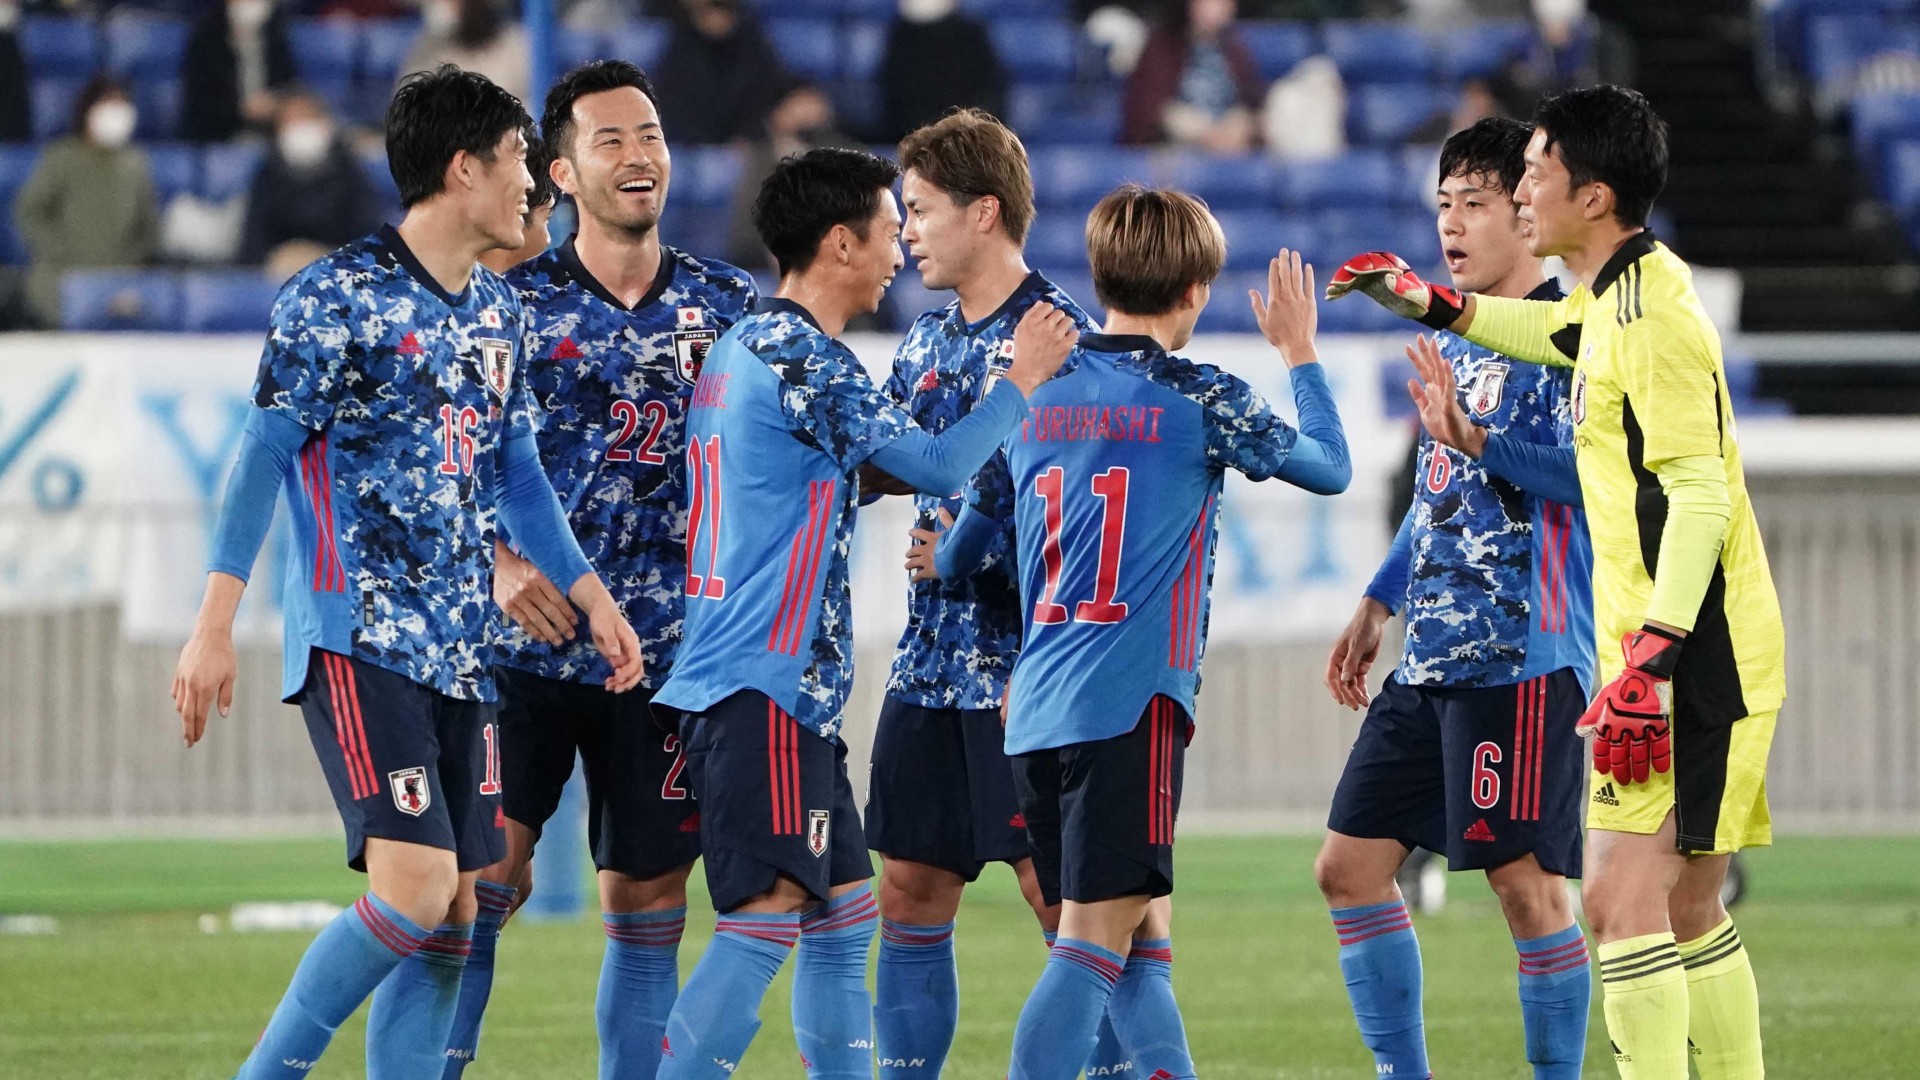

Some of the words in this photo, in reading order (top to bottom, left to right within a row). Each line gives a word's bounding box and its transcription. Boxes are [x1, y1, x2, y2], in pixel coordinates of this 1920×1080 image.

[682, 332, 708, 340] JAPAN
[439, 403, 479, 477] 16
[604, 399, 669, 466] 22
[1020, 407, 1164, 443] FURUHASHI
[1427, 438, 1452, 494] 6
[685, 434, 726, 599] 21
[1033, 466, 1130, 624] 11
[480, 723, 502, 796] 1
[661, 733, 698, 800] 2
[1471, 741, 1503, 810] 6
[1593, 795, 1620, 807] adidas
[713, 1057, 737, 1074] JA
[1614, 1054, 1632, 1063] as
